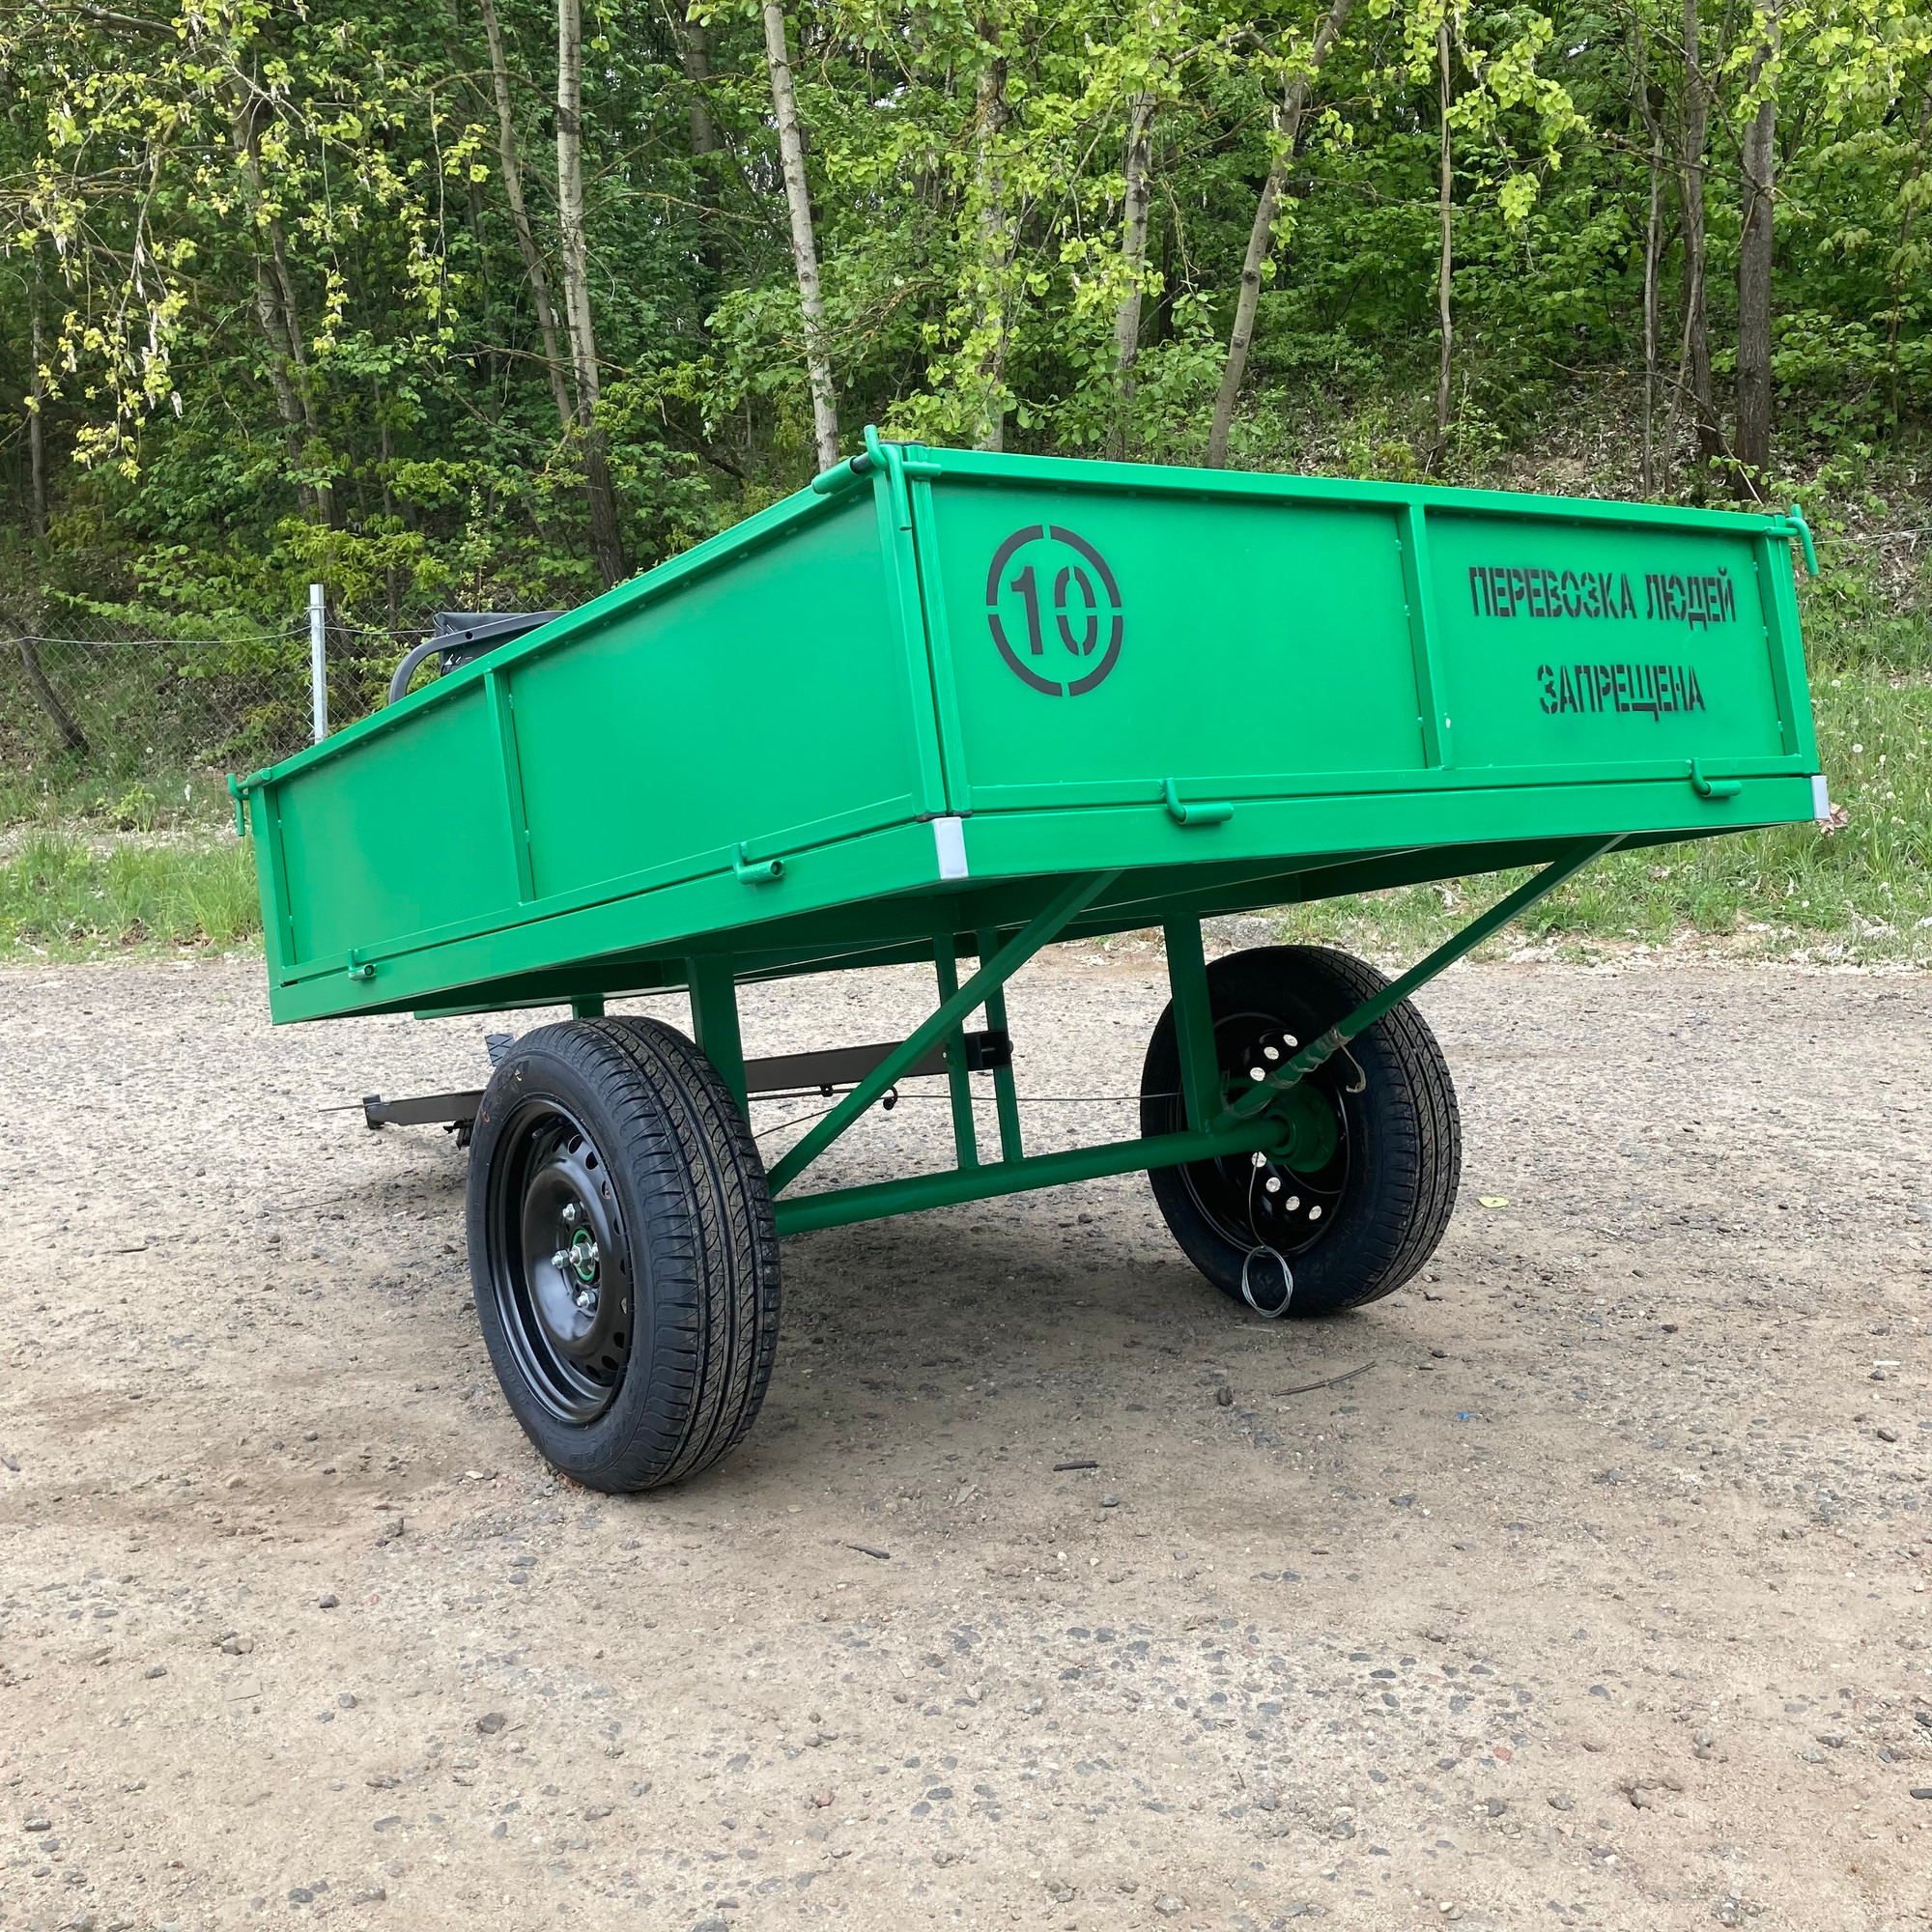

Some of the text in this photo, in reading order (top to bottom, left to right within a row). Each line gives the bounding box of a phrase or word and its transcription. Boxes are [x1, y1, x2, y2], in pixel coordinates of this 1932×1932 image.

[1010, 566, 1098, 656] 10
[1468, 566, 1736, 631] ПЕРЕВОЗКА ЛЮДЕЙ
[1537, 664, 1705, 722] ЗАПРЕЩЕНА
